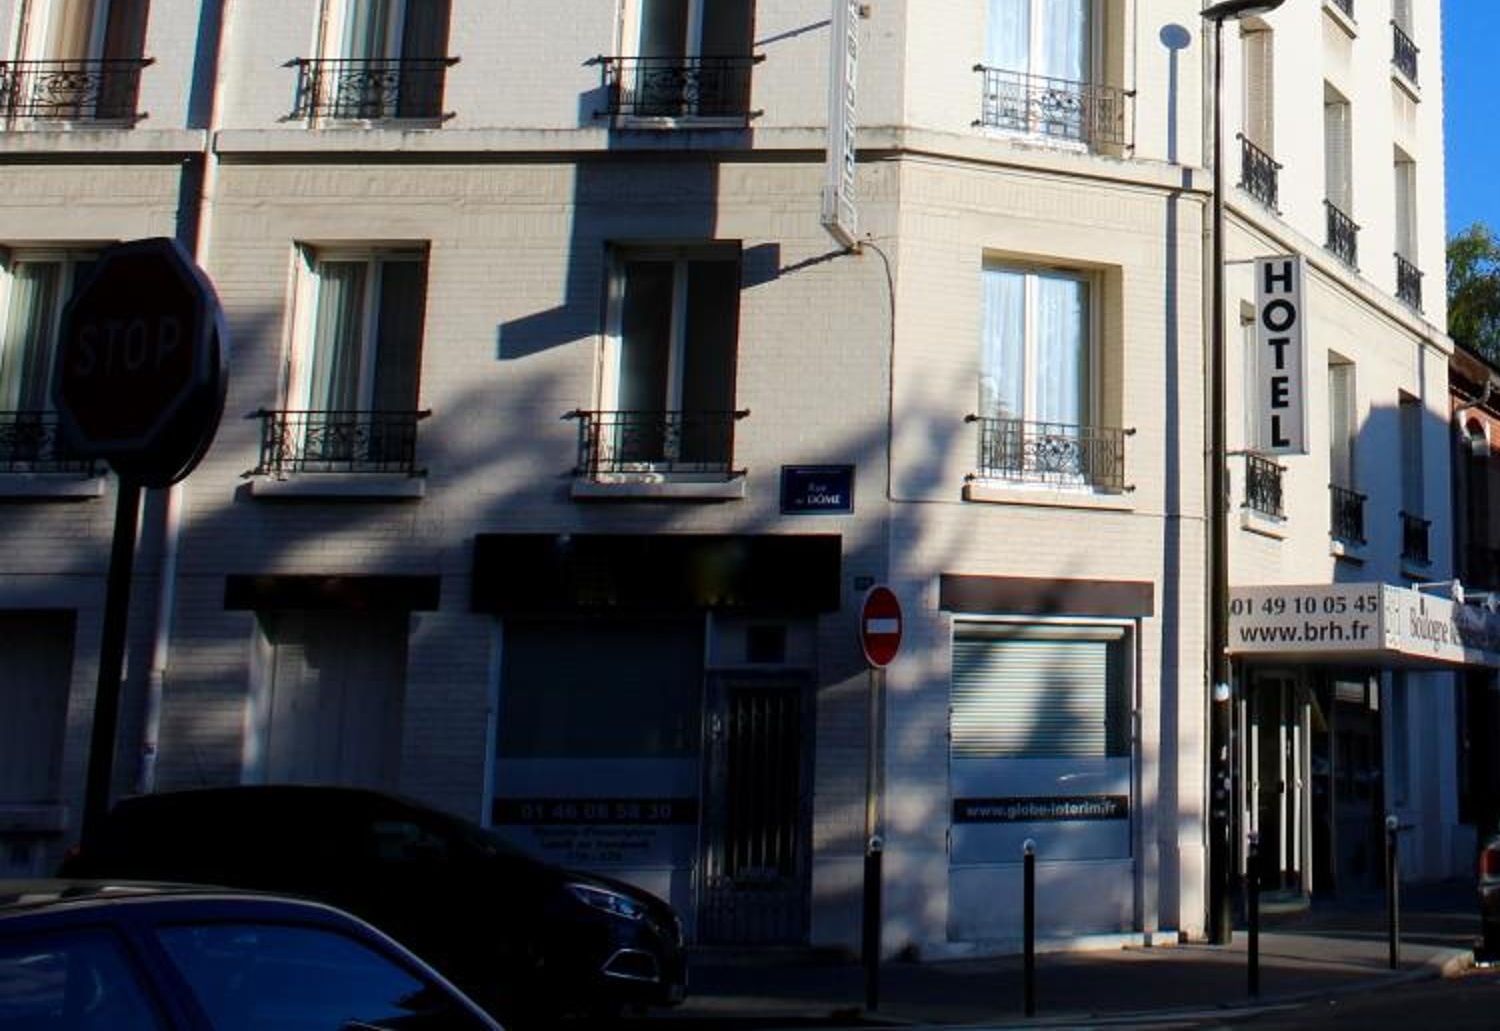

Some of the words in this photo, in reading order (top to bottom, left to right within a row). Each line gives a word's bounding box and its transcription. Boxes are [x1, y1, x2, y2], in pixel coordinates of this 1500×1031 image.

[72, 314, 182, 377] STOP
[1262, 261, 1296, 448] HOTEL
[1231, 597, 1252, 616] 01
[1262, 597, 1285, 616] 49
[1295, 596, 1316, 614] 10
[1323, 595, 1346, 614] 05
[1354, 595, 1377, 613] 45
[1240, 620, 1370, 642] www.brh.fr
[966, 798, 1119, 820] www.globe-interim.fr
